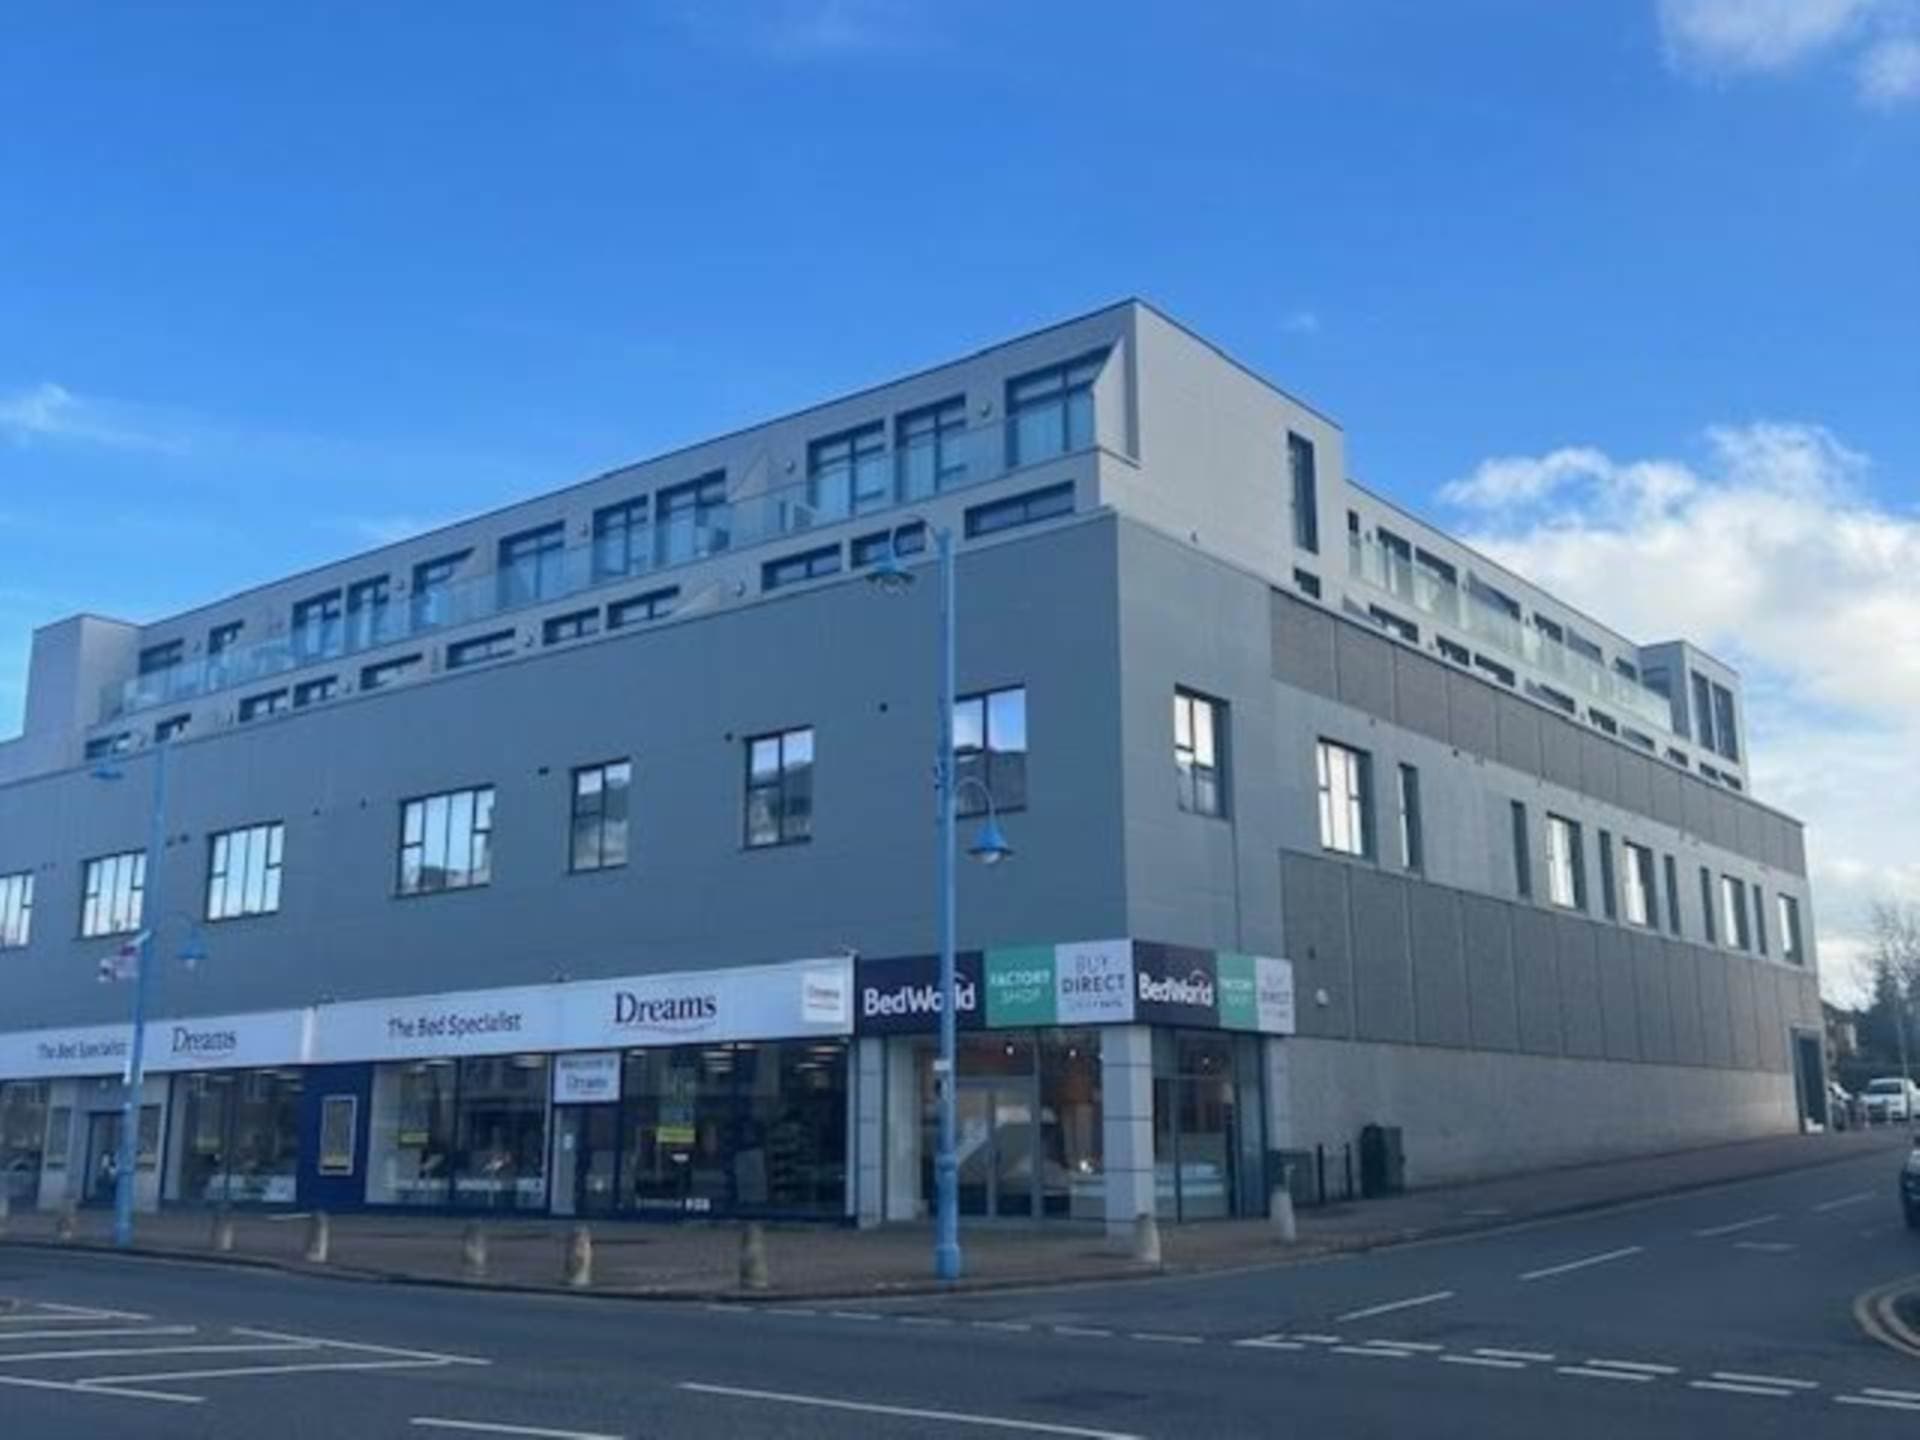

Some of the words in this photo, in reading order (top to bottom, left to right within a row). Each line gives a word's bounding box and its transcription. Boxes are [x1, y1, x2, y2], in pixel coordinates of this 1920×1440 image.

[1076, 955, 1108, 975] BUY
[1061, 973, 1127, 995] DIRECT
[1138, 971, 1214, 1007] BedWorld
[614, 991, 717, 1024] Dreams
[863, 982, 976, 1017] BedWold
[388, 1017, 414, 1038] The
[418, 1014, 445, 1037] Bed
[448, 1010, 522, 1038] Specialist
[172, 1025, 237, 1052] Dreams
